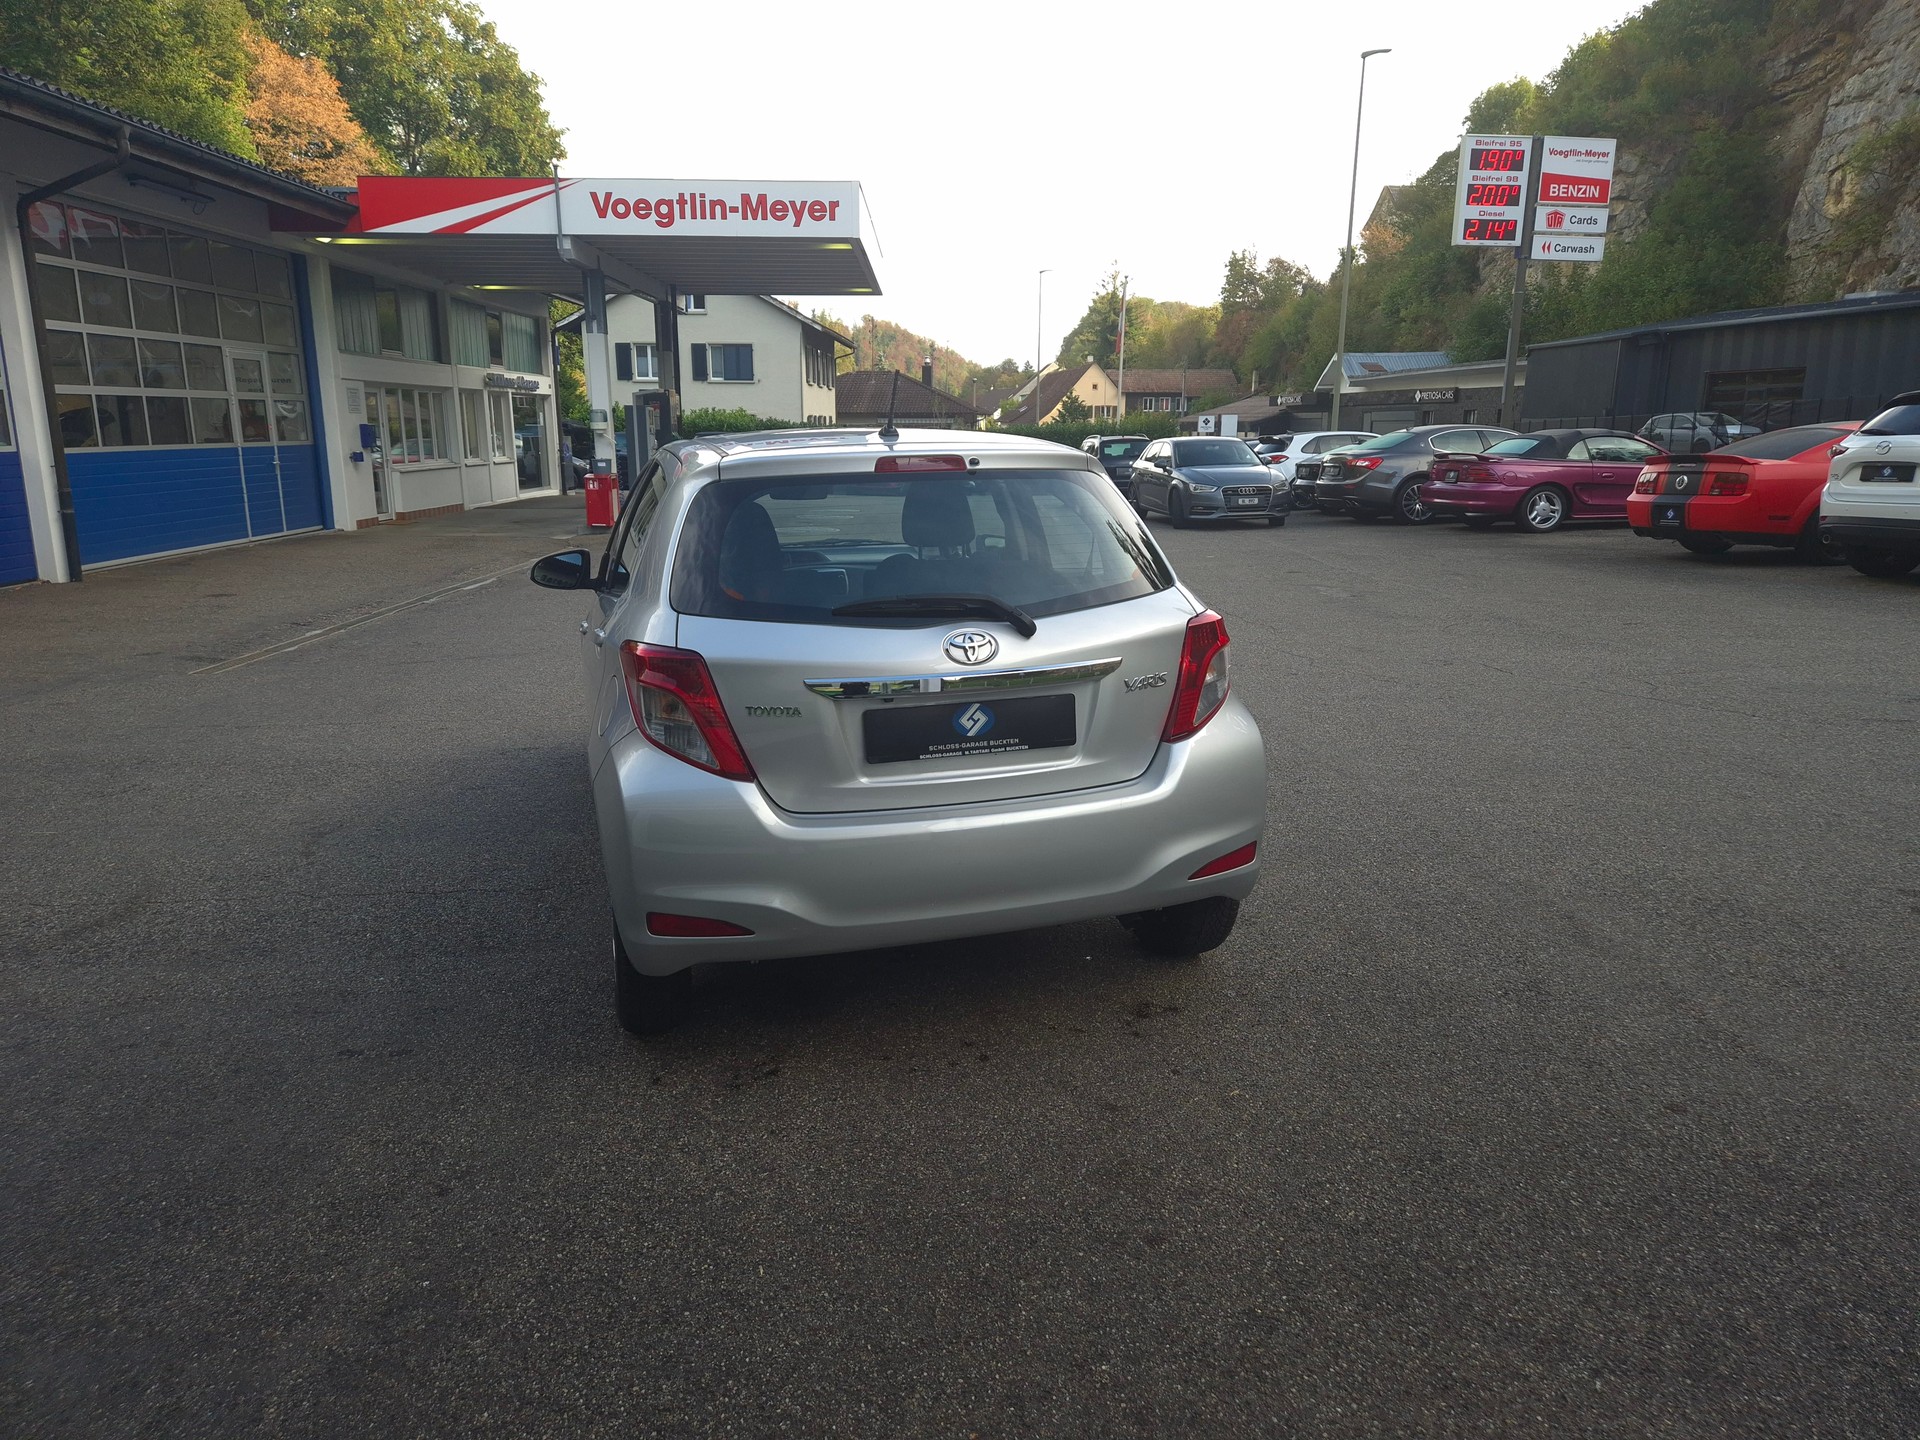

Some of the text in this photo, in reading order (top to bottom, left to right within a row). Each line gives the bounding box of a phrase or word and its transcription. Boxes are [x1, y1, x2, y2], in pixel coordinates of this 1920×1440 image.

[1475, 139, 1507, 147] Bleifrei
[1548, 147, 1610, 159] Voegtlin-Meyer
[1549, 184, 1600, 198] BENZIN
[589, 191, 840, 228] Voegtlin-Meyer
[1546, 211, 1598, 228] UTA Cards
[1554, 243, 1595, 254] Carwash
[744, 705, 803, 718] TOYOTA
[928, 738, 1020, 752] SCHLOSS-GARAGE BUCKTEN
[919, 751, 963, 760] SCHLOSS-GARAGE
